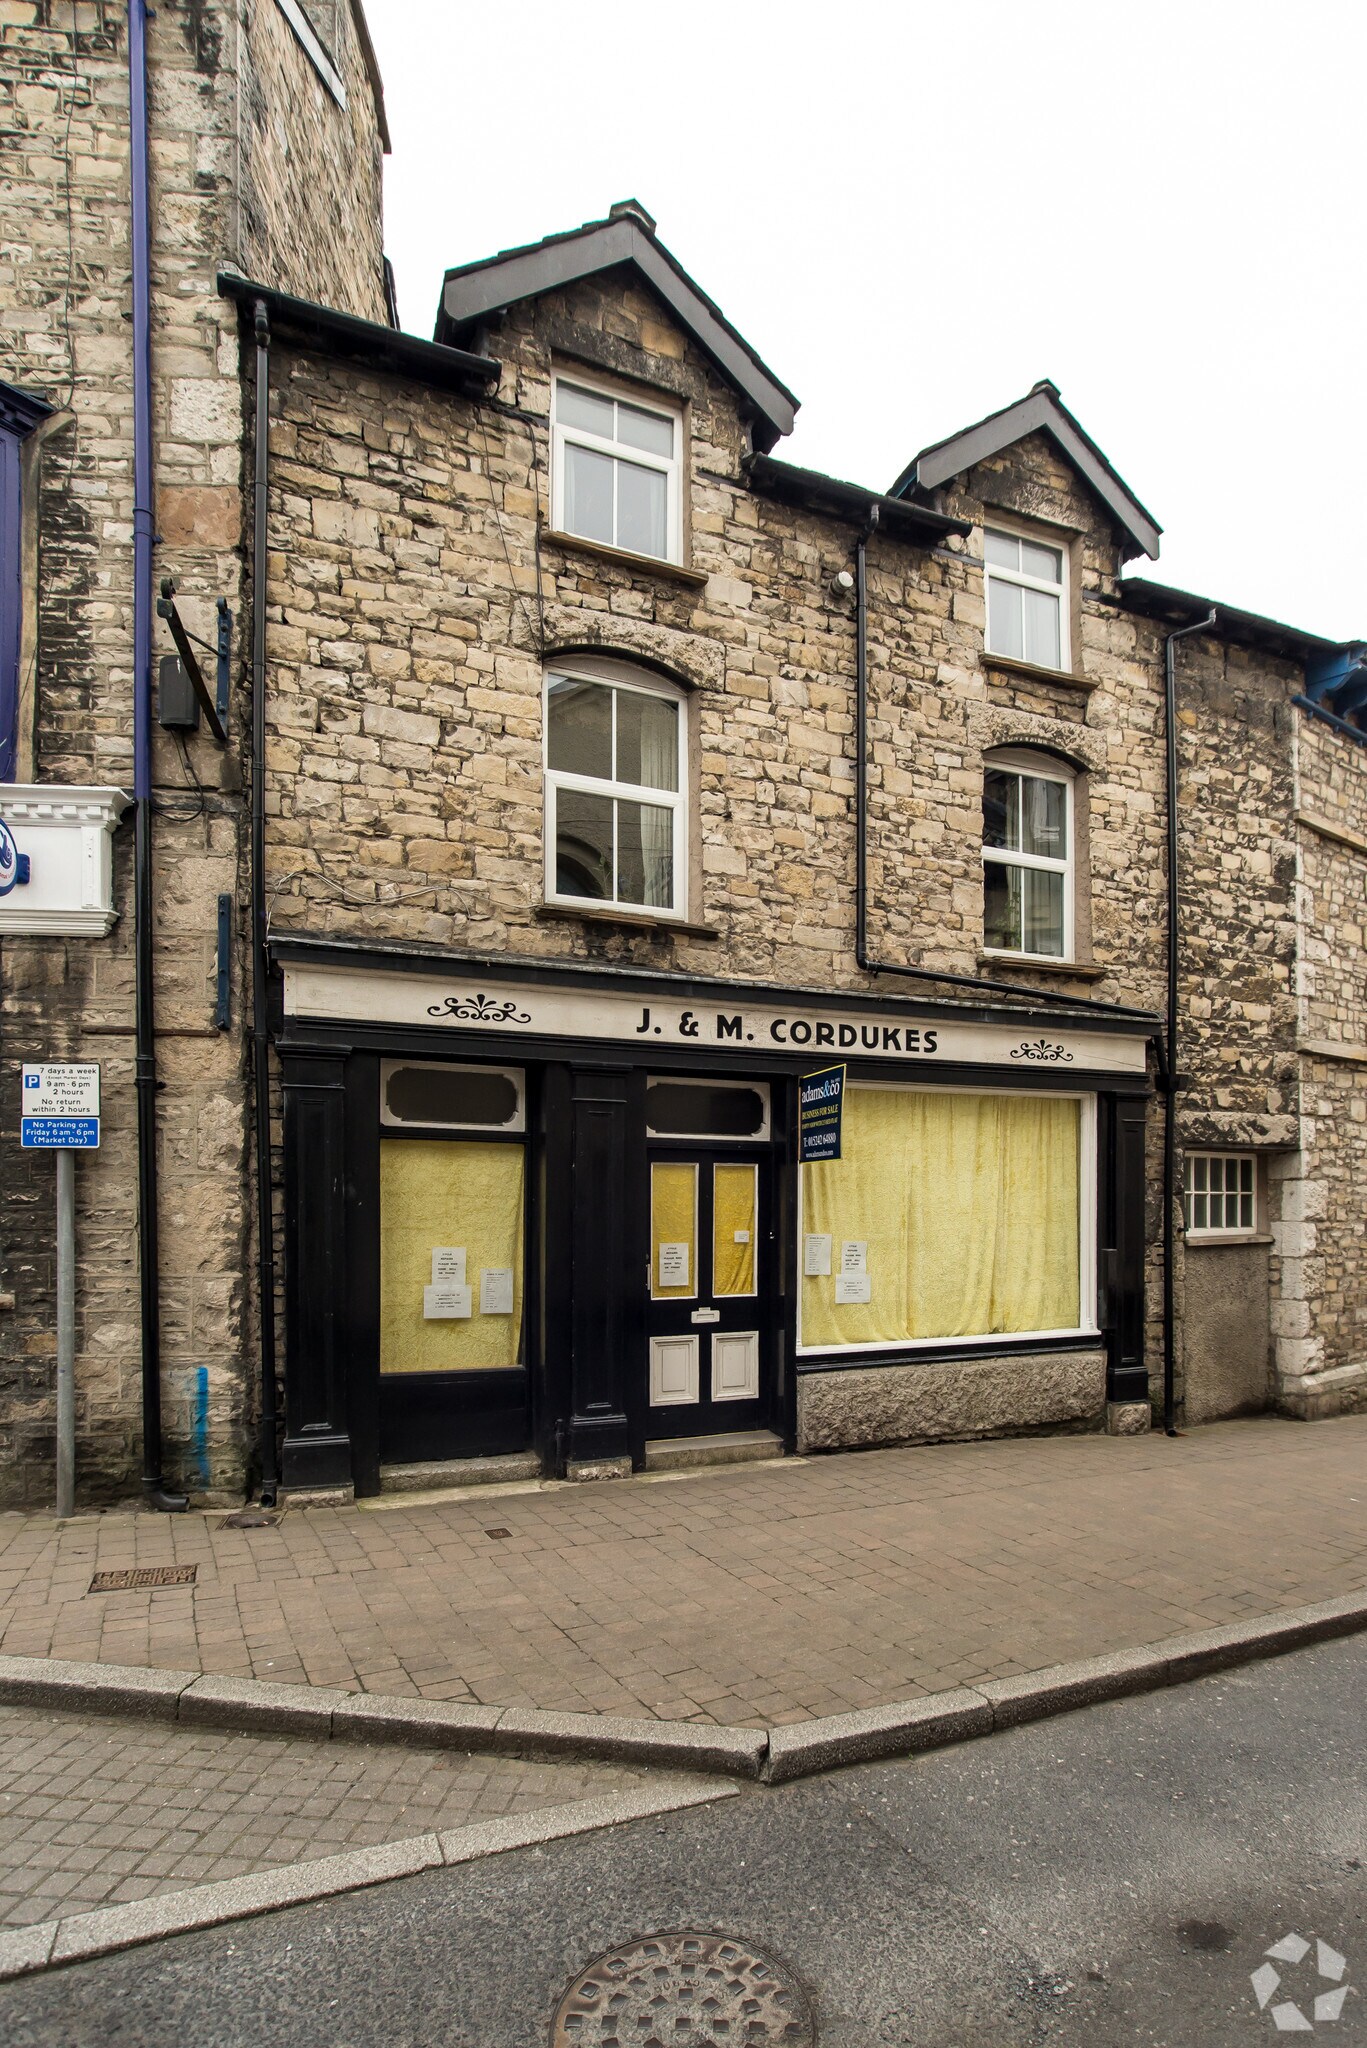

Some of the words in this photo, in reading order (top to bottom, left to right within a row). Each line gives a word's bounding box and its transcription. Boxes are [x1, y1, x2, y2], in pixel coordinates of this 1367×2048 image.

[636, 1008, 662, 1035] J.
[679, 1011, 699, 1037] &
[716, 1014, 754, 1041] M.
[770, 1018, 938, 1053] CORDUKES
[47, 1067, 66, 1075] days
[28, 1076, 39, 1087] P
[802, 1080, 840, 1103] adams&co
[827, 1104, 839, 1114] SALE
[47, 1121, 76, 1129] Parking
[33, 1136, 66, 1144] (Market
[68, 1136, 88, 1144] Day)
